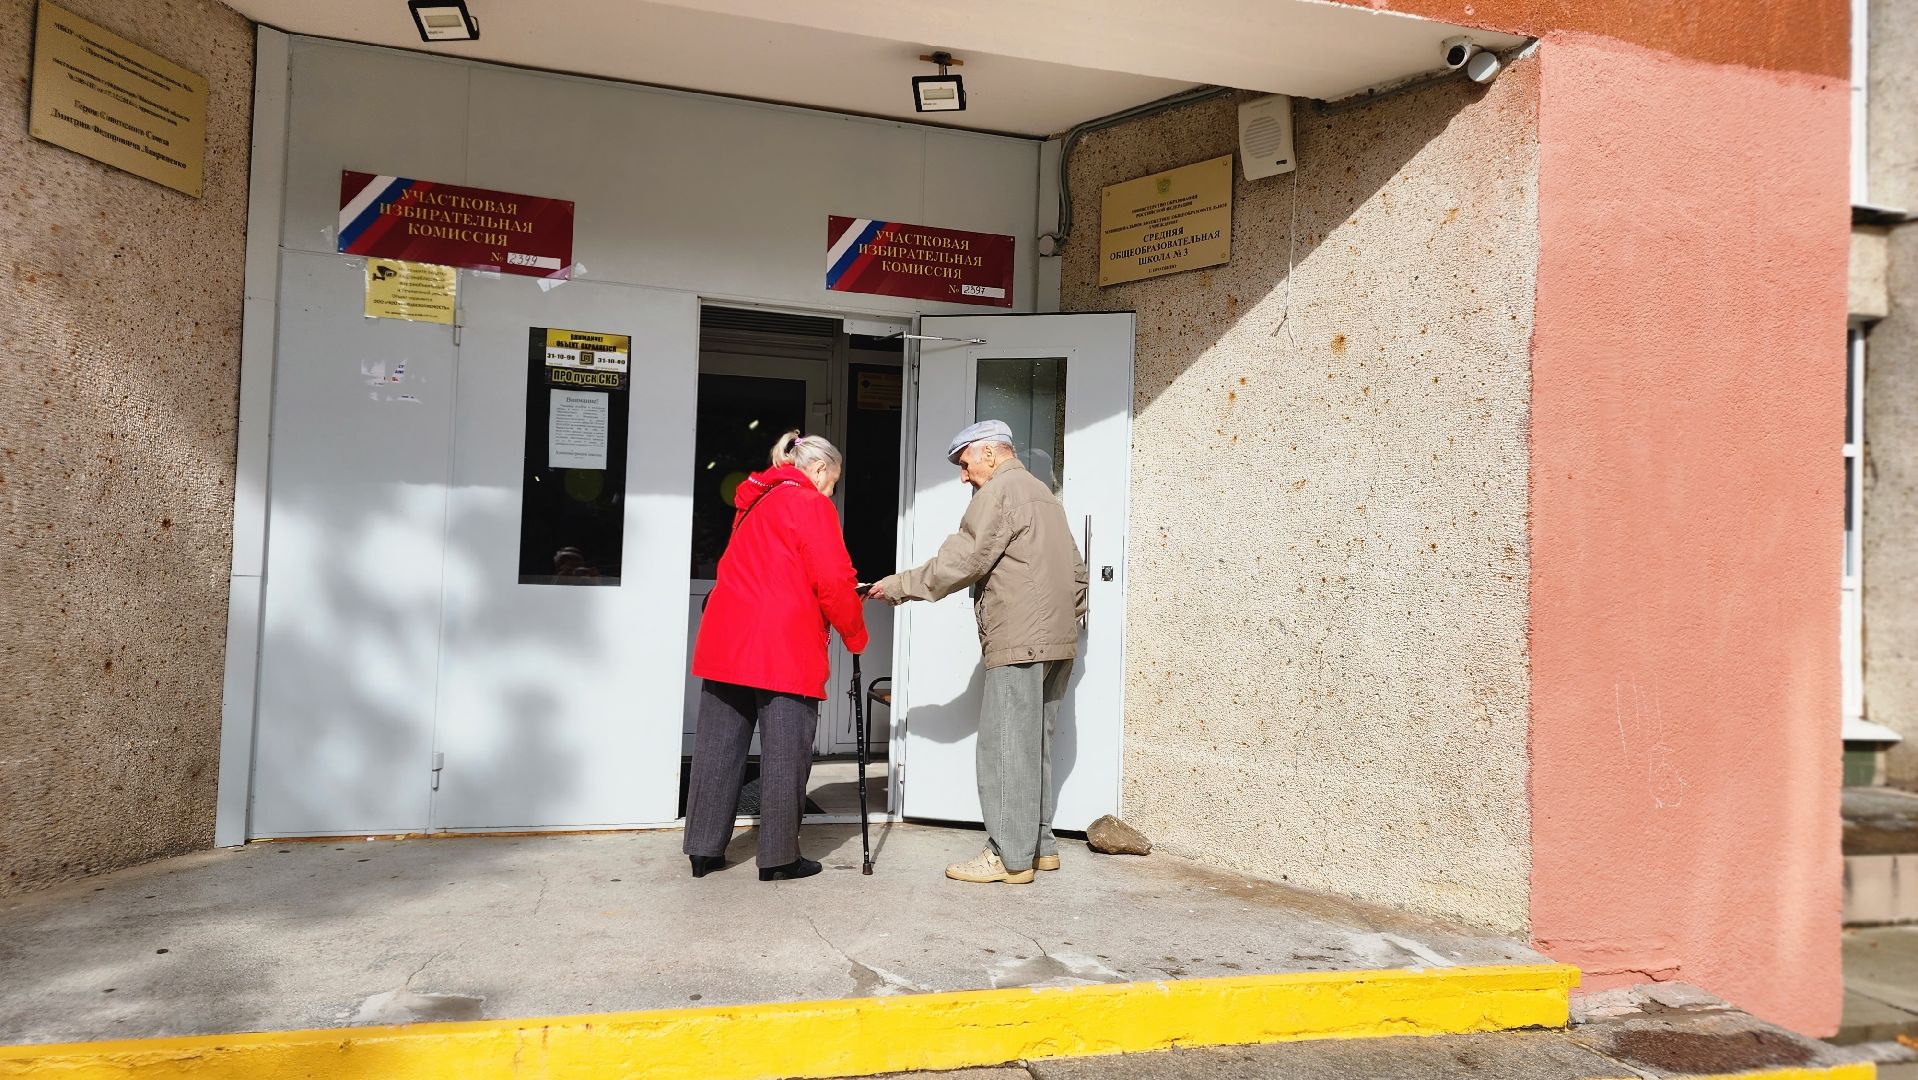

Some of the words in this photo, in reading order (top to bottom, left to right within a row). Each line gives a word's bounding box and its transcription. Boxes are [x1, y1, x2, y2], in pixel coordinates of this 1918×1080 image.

[401, 188, 518, 216] УЧАСТКОВАЯ
[379, 202, 534, 234] ИЗБИРАТЕЛЬНАЯ
[408, 223, 508, 247] КОМИССИЯ
[876, 230, 970, 251] УЧАСТКОВАЯ
[1143, 226, 1184, 243] СРЕДНЯЯ
[858, 243, 983, 267] ИЗБИРАТЕЛЬНАЯ
[1109, 229, 1221, 261] ОБЩЕОБРАЗОВАТЕЛЬНАЯ
[1138, 252, 1171, 266] ШКОЛА
[1172, 249, 1182, 259] №
[1183, 247, 1189, 257] 3
[882, 260, 962, 280] КОМИССИЯ
[948, 284, 960, 294] №
[556, 340, 579, 349] ОБЪЕКТ
[580, 343, 617, 353] ОХРАНЯЕТСЯ
[553, 370, 573, 381] ПРО
[599, 373, 618, 385] СКБ
